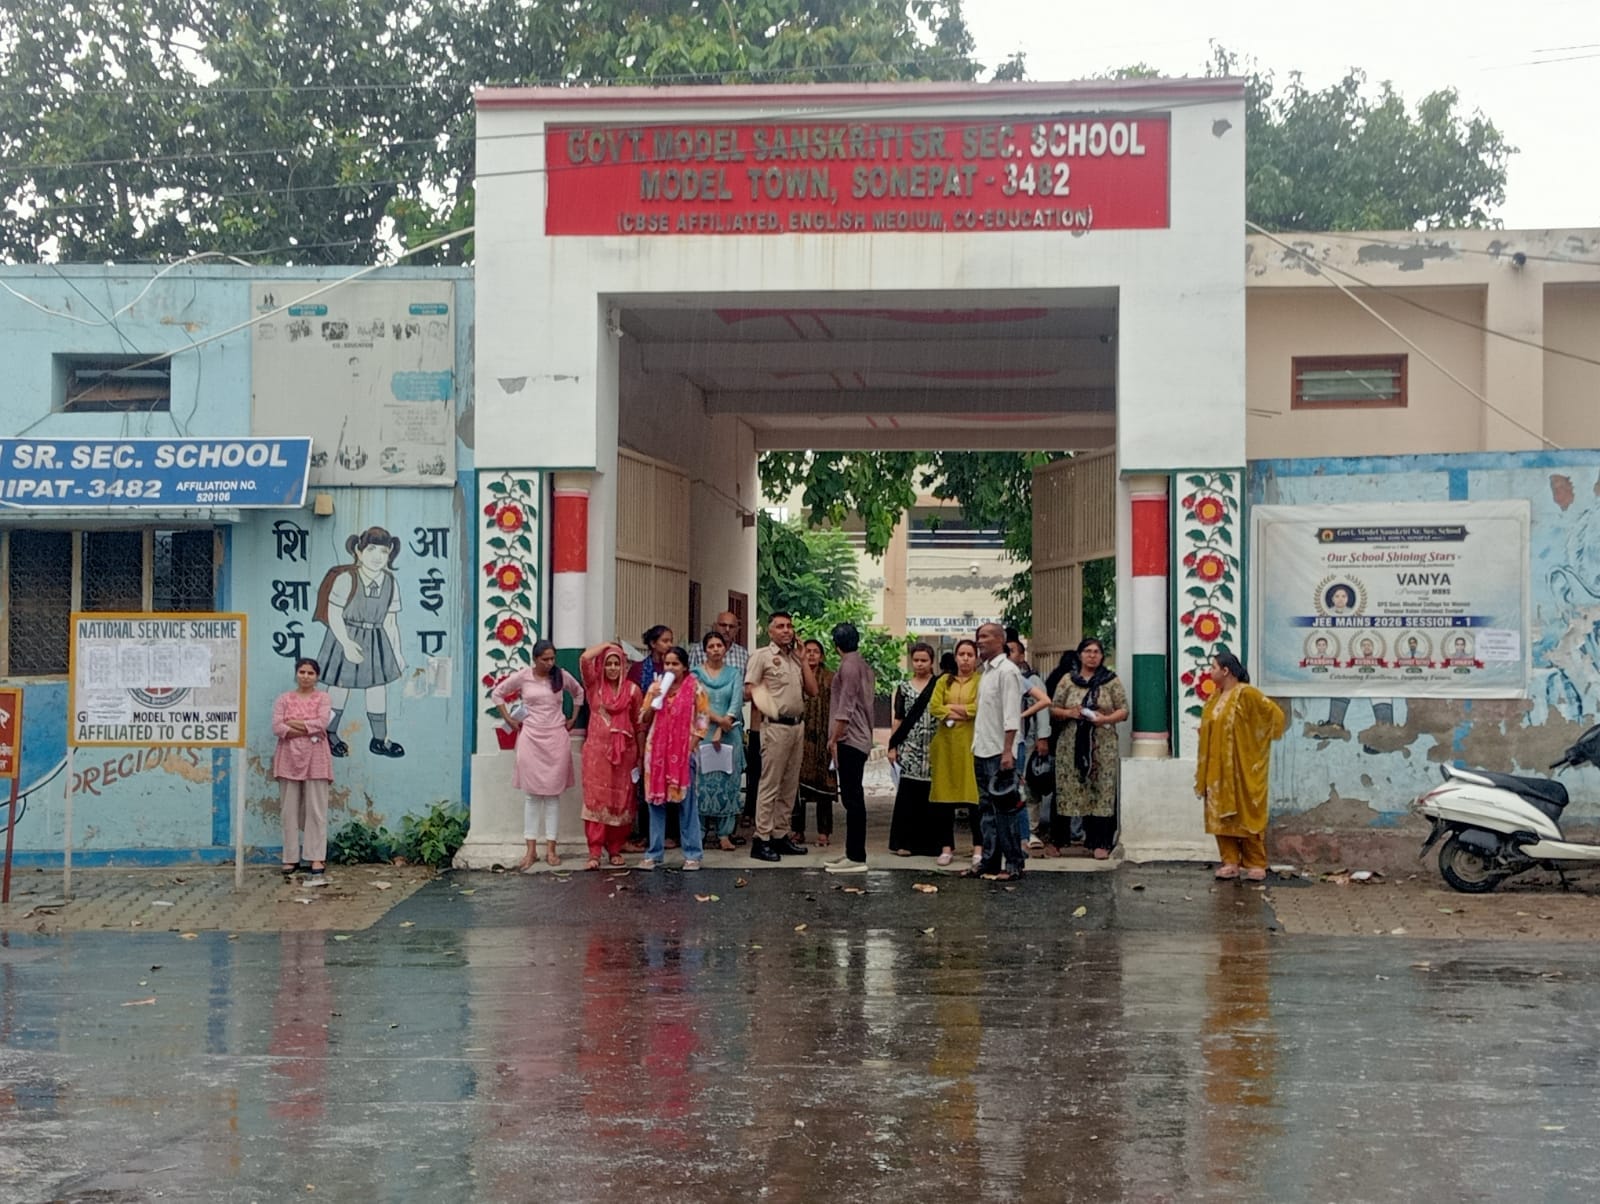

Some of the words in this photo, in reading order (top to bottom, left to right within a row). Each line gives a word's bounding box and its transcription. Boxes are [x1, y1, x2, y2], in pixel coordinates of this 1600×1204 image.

[567, 129, 645, 163] GOVT.
[653, 129, 746, 162] MODEL
[753, 126, 904, 162] SANSKRITI
[911, 127, 953, 160] SR.
[962, 126, 1023, 159] SEC.
[1030, 121, 1146, 158] SCHOOL
[640, 168, 733, 201] MODEL
[748, 166, 838, 205] TOWN,
[852, 165, 979, 199] SONEPAT
[1002, 163, 1070, 197] 3482
[617, 213, 669, 232] (CBSE
[788, 212, 866, 231] ENGLISH
[872, 211, 947, 232] MEDIUM,
[12, 444, 63, 470] SR.
[70, 444, 143, 470] SEC.
[154, 443, 288, 469] SCHOOL
[176, 481, 237, 492] AFFILIATION
[240, 480, 257, 491] NO.
[1327, 552, 1348, 562] Our
[1349, 552, 1385, 563] School
[1386, 552, 1428, 564] Shining
[1428, 551, 1456, 563] Stars
[1396, 573, 1451, 586] VANYA
[920, 618, 942, 627] MODEL
[1312, 617, 1333, 628] JEE
[1335, 617, 1371, 628] MAINS
[1405, 616, 1452, 628] SESSION
[1466, 616, 1472, 627] 1
[79, 622, 135, 639] NATIONAL
[138, 621, 186, 638] SERVICE
[190, 621, 237, 639] SCHEME
[133, 711, 166, 723] MODEL
[205, 711, 238, 723] SONIPAT
[78, 725, 153, 740] AFFILIATED
[159, 725, 174, 740] TO
[181, 724, 229, 740] CBSE
